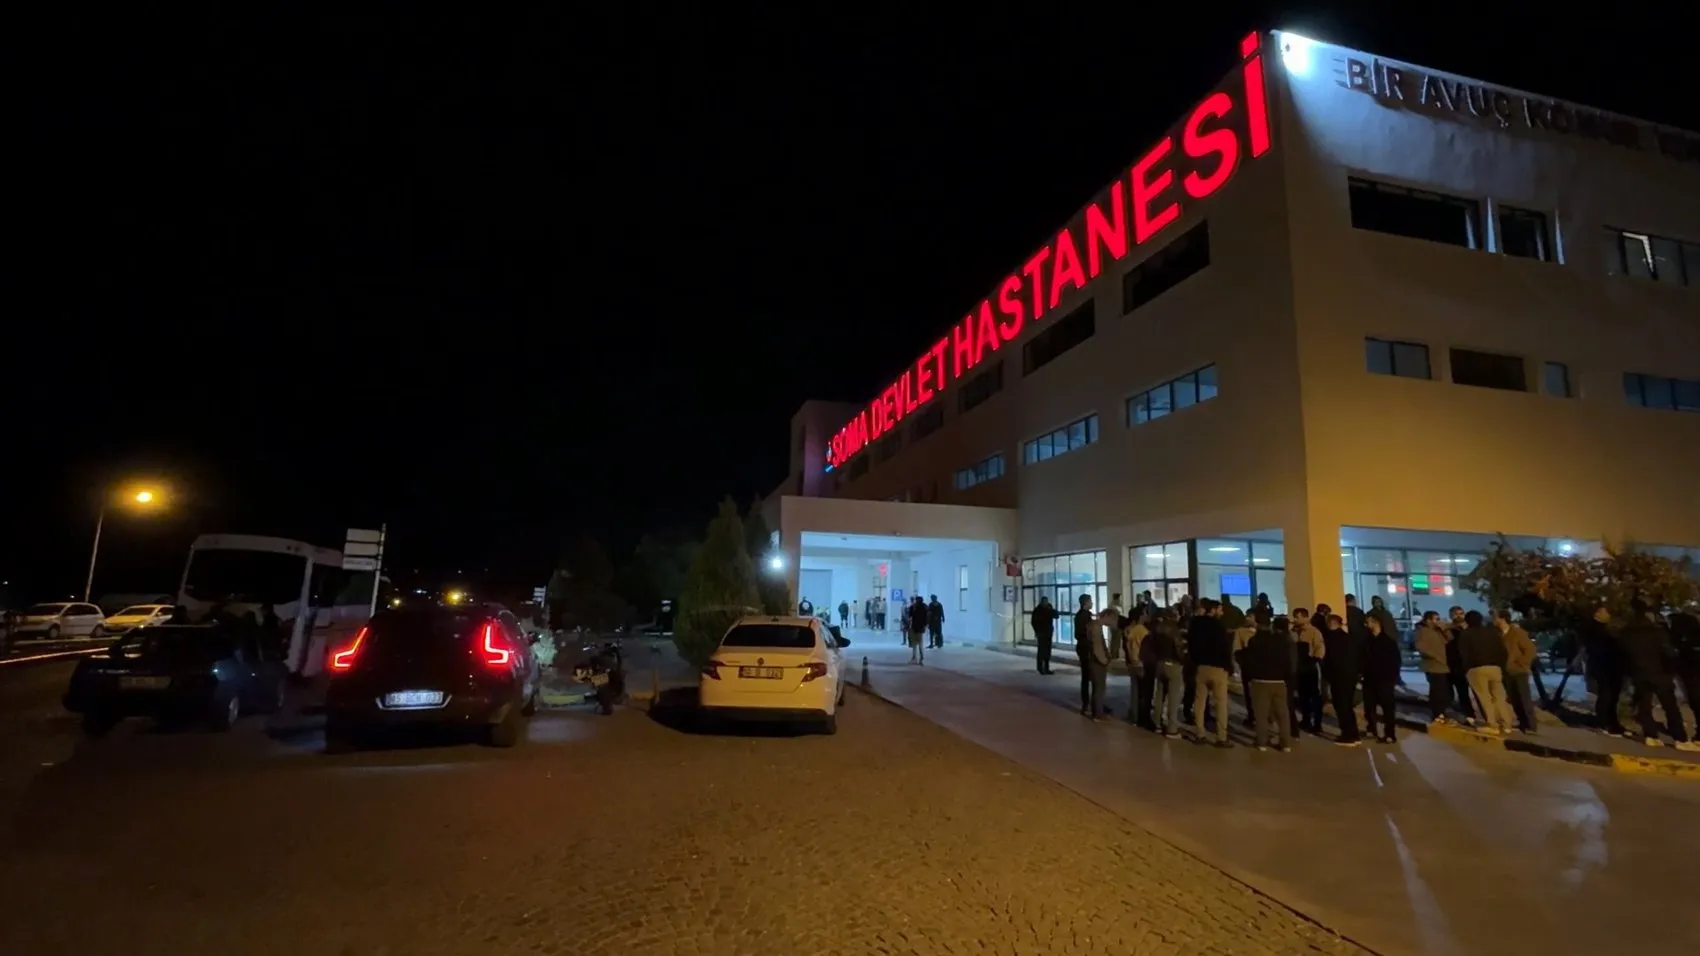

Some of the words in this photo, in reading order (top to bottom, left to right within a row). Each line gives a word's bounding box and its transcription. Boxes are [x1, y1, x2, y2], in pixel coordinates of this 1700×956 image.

[1346, 56, 1404, 101] BİR
[1420, 74, 1510, 127] AVUÇ
[832, 411, 870, 468] SOMA
[871, 337, 950, 441] DEVLET
[954, 31, 1271, 378] HASTANESİ
